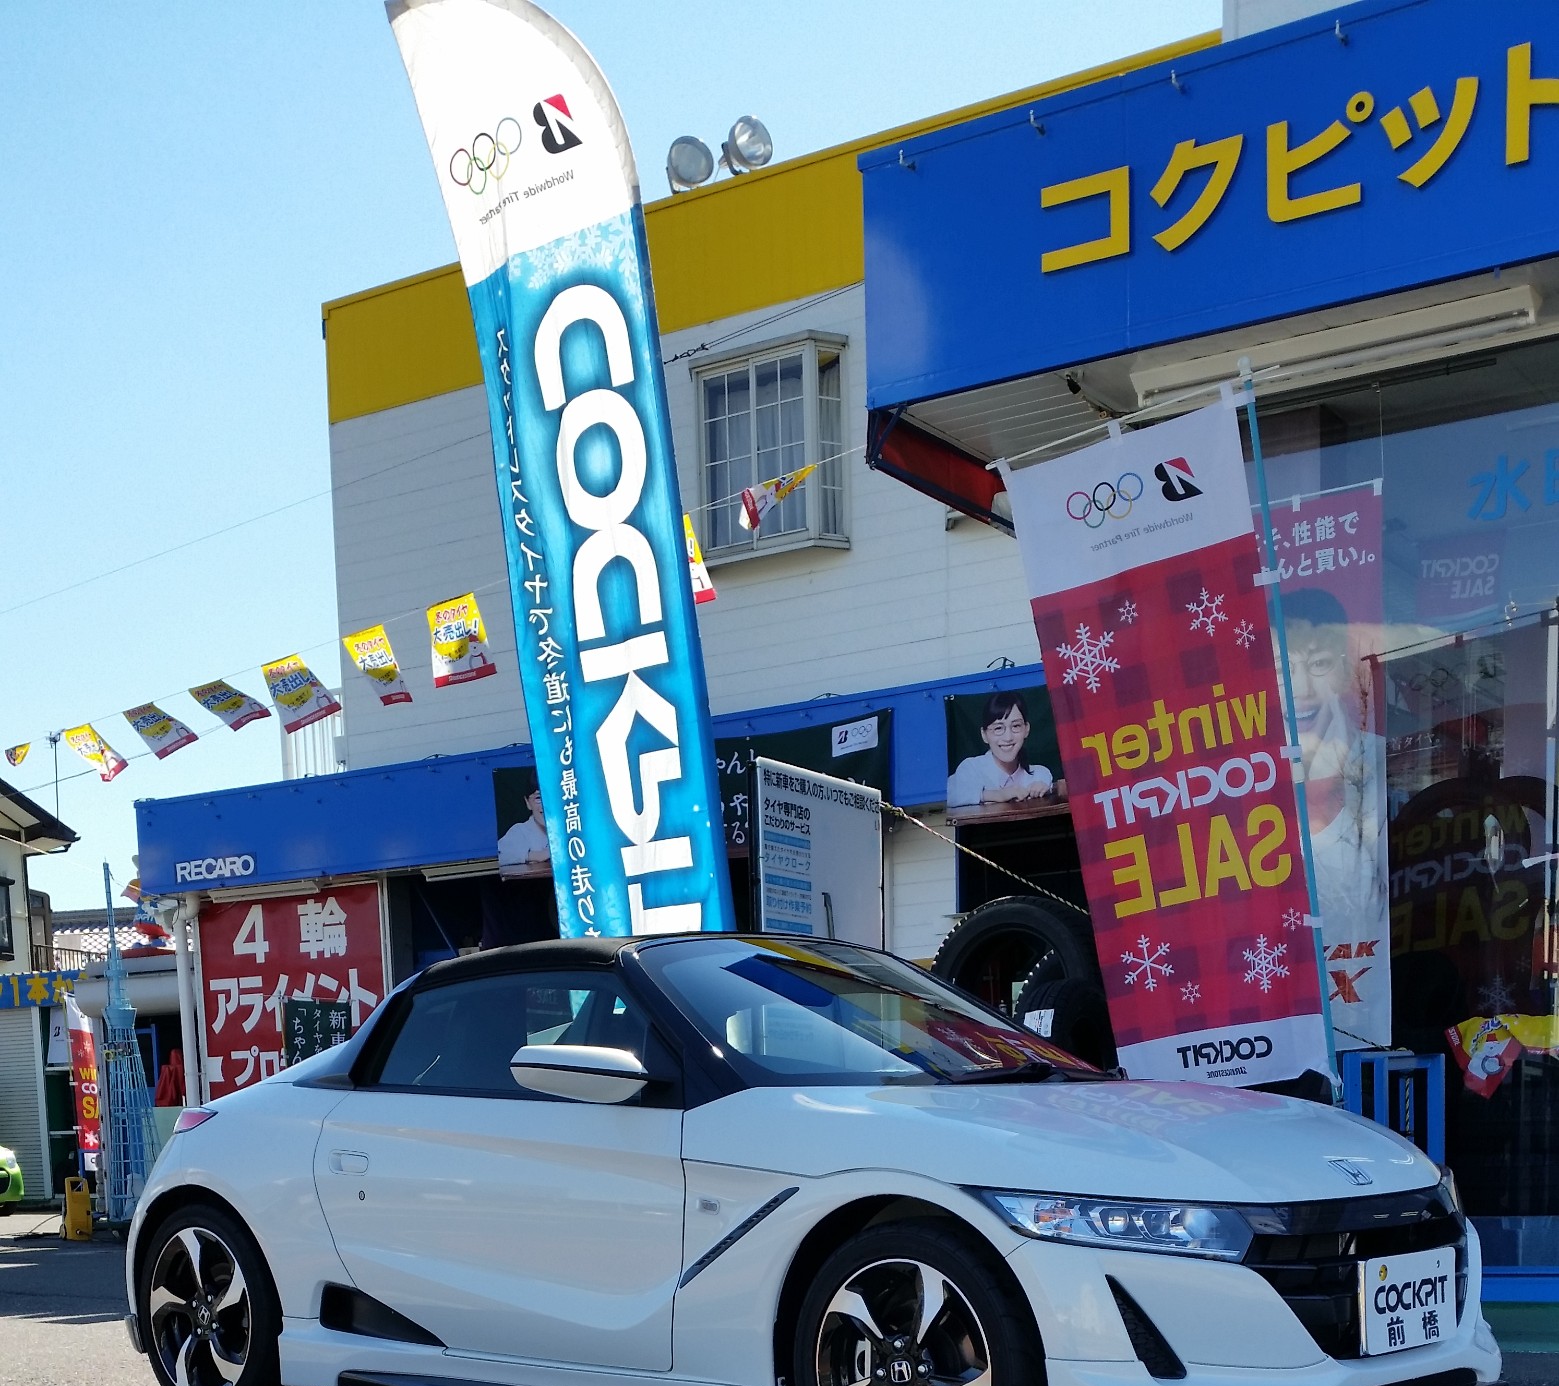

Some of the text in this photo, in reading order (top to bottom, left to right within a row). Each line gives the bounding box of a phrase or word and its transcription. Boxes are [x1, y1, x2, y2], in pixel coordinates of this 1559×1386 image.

[1041, 42, 1559, 273] コクピット
[176, 855, 255, 883] RECARO
[230, 1045, 288, 1087] プロ
[1373, 1275, 1448, 1315] COCKPIT
[1387, 1310, 1440, 1347] 前橋
